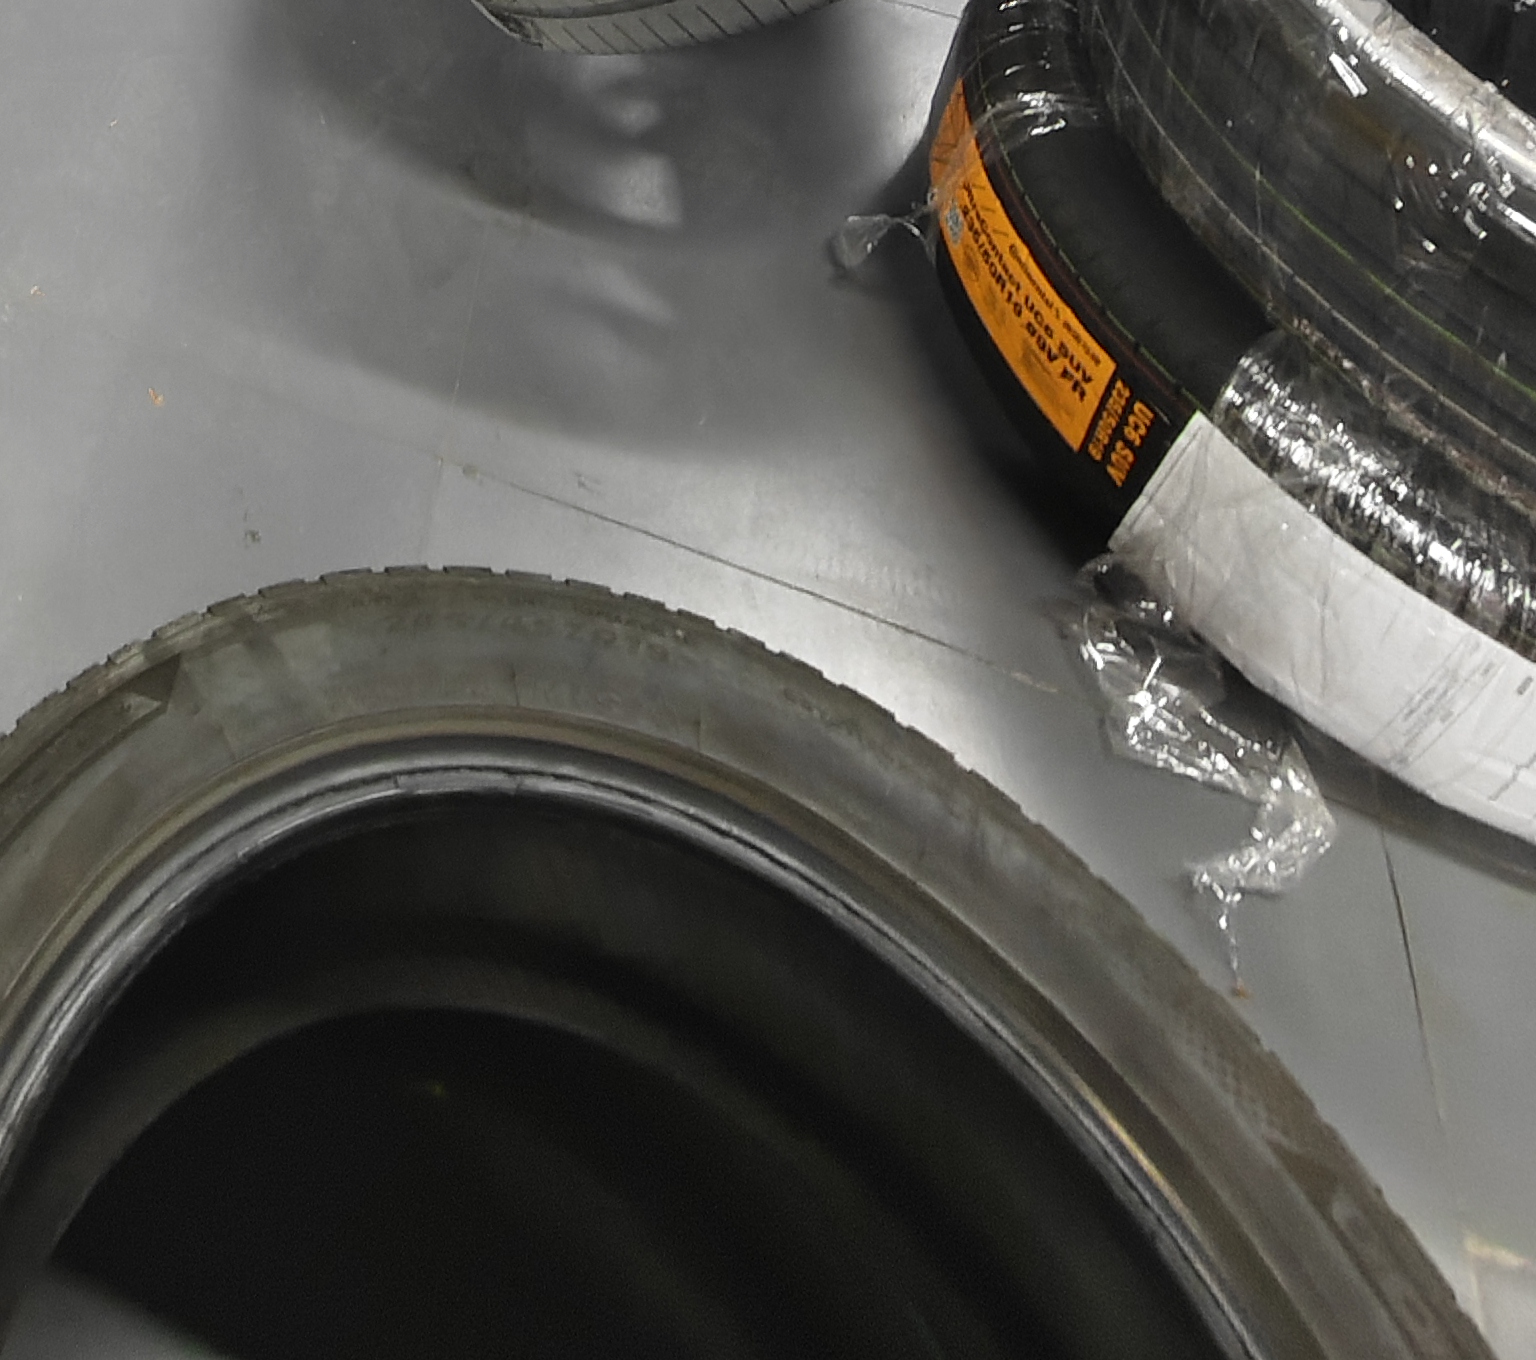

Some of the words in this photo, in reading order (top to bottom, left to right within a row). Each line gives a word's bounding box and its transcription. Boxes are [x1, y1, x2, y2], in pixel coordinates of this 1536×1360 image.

[1059, 339, 1094, 386] SUV
[1059, 367, 1088, 403] FR
[1123, 400, 1156, 448] UC6
[1106, 440, 1137, 487] SUV
